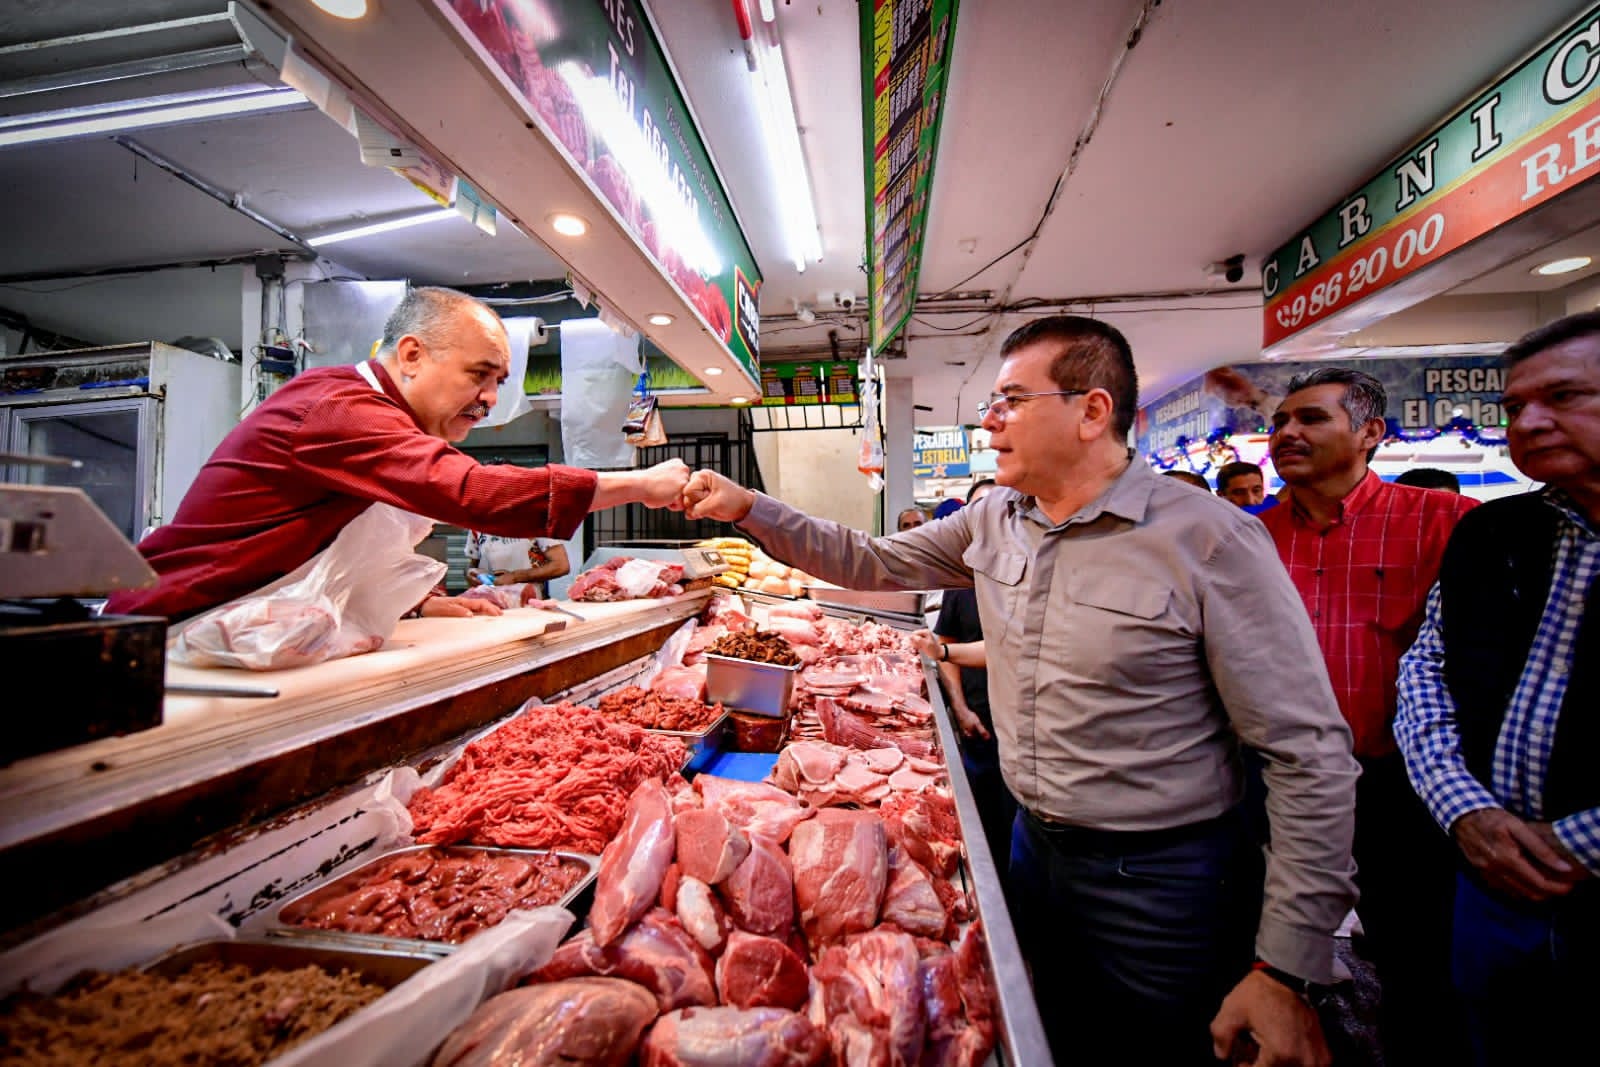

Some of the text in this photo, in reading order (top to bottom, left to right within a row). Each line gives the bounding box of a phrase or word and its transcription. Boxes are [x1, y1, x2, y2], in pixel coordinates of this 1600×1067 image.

[1426, 368, 1507, 393] PESCA
[1404, 399, 1428, 428] El
[922, 448, 968, 464] ESTRELLA
